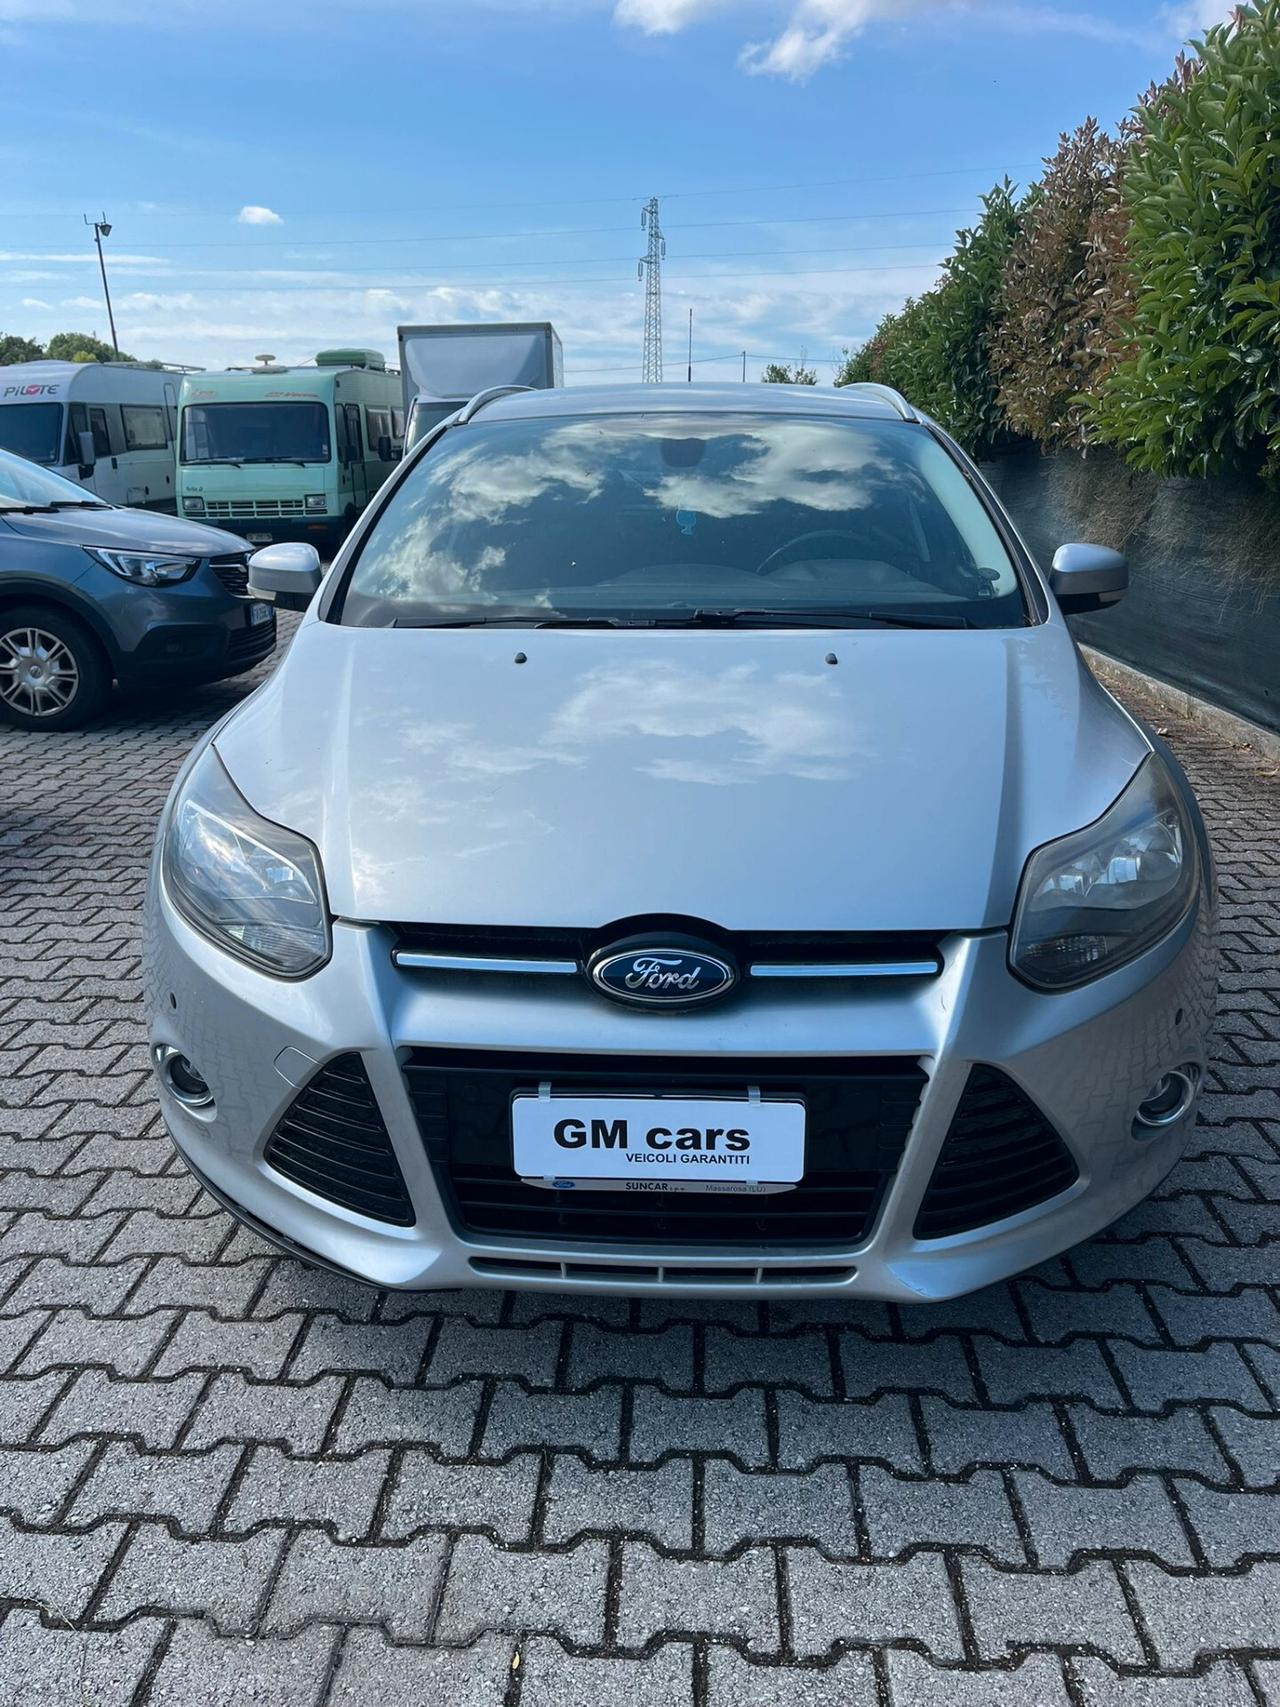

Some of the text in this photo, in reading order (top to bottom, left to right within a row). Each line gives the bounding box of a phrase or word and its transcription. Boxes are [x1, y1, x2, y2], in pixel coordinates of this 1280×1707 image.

[624, 957, 702, 990] Ford
[554, 1118, 751, 1151] GM cars
[626, 1152, 751, 1165] VEICOLI GARANTITI
[625, 1182, 669, 1191] SUNCAR
